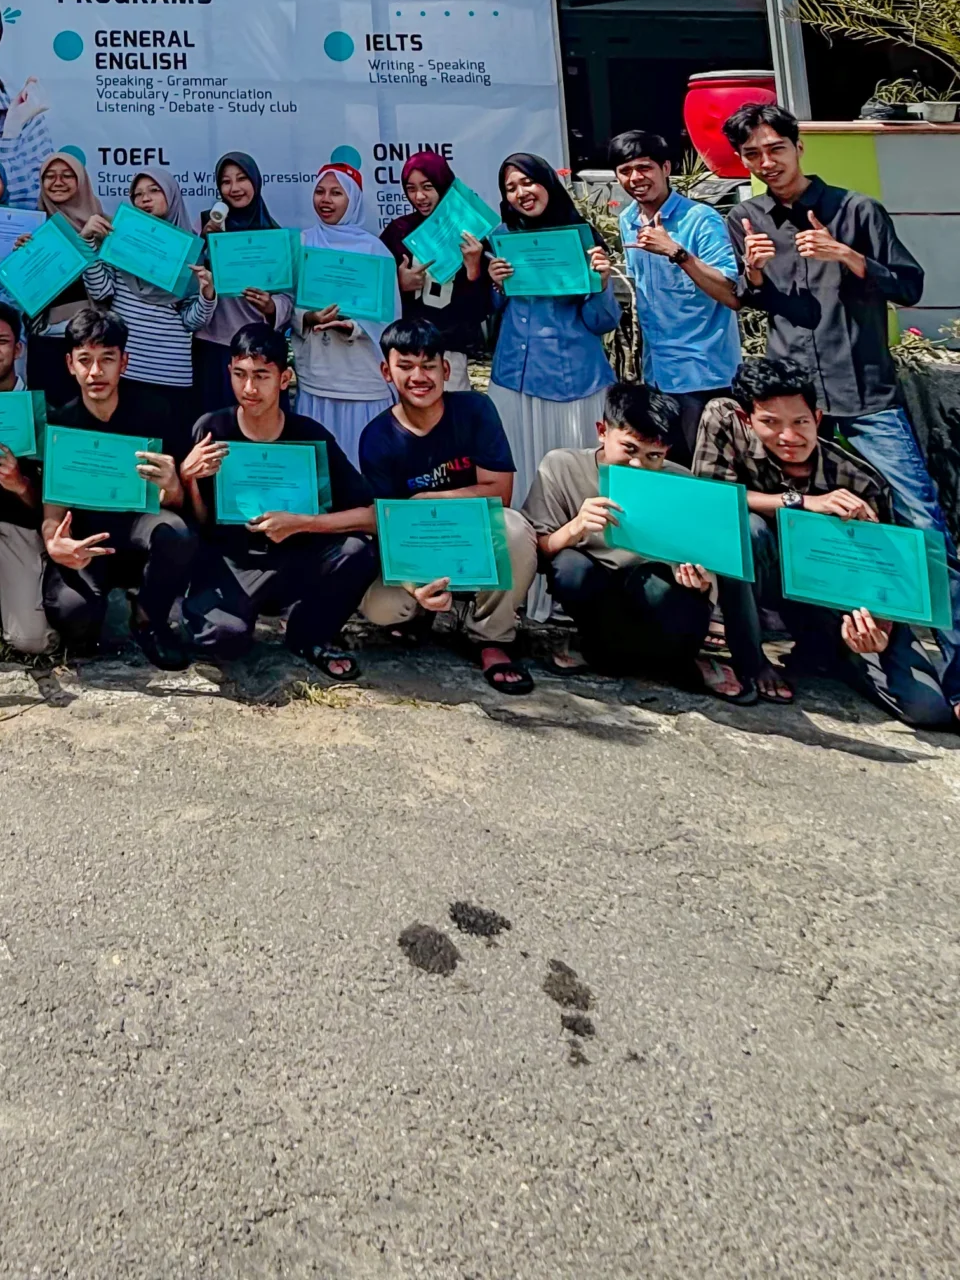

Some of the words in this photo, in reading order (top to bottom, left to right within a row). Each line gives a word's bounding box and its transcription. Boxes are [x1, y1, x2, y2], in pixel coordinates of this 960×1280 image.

[95, 30, 195, 48] GENERAL
[365, 33, 423, 51] IELTS
[95, 52, 188, 70] ENGLISH
[368, 59, 415, 73] Writing
[428, 58, 486, 73] Speaking
[96, 75, 154, 89] Speaking
[167, 75, 228, 86] Grammar
[369, 72, 428, 87] Listening
[441, 72, 491, 87] Reading
[96, 88, 169, 102] Vocabulary
[183, 88, 272, 100] Pronunciation
[96, 101, 155, 116] Listening
[169, 101, 215, 113] Debate
[228, 101, 265, 116] Study
[269, 101, 298, 113] club
[98, 147, 170, 166] TOEFL
[98, 171, 133, 183] Struc
[263, 172, 318, 186] pression
[98, 186, 130, 197] Liste
[180, 185, 220, 200] eading
[376, 190, 408, 202] Gene
